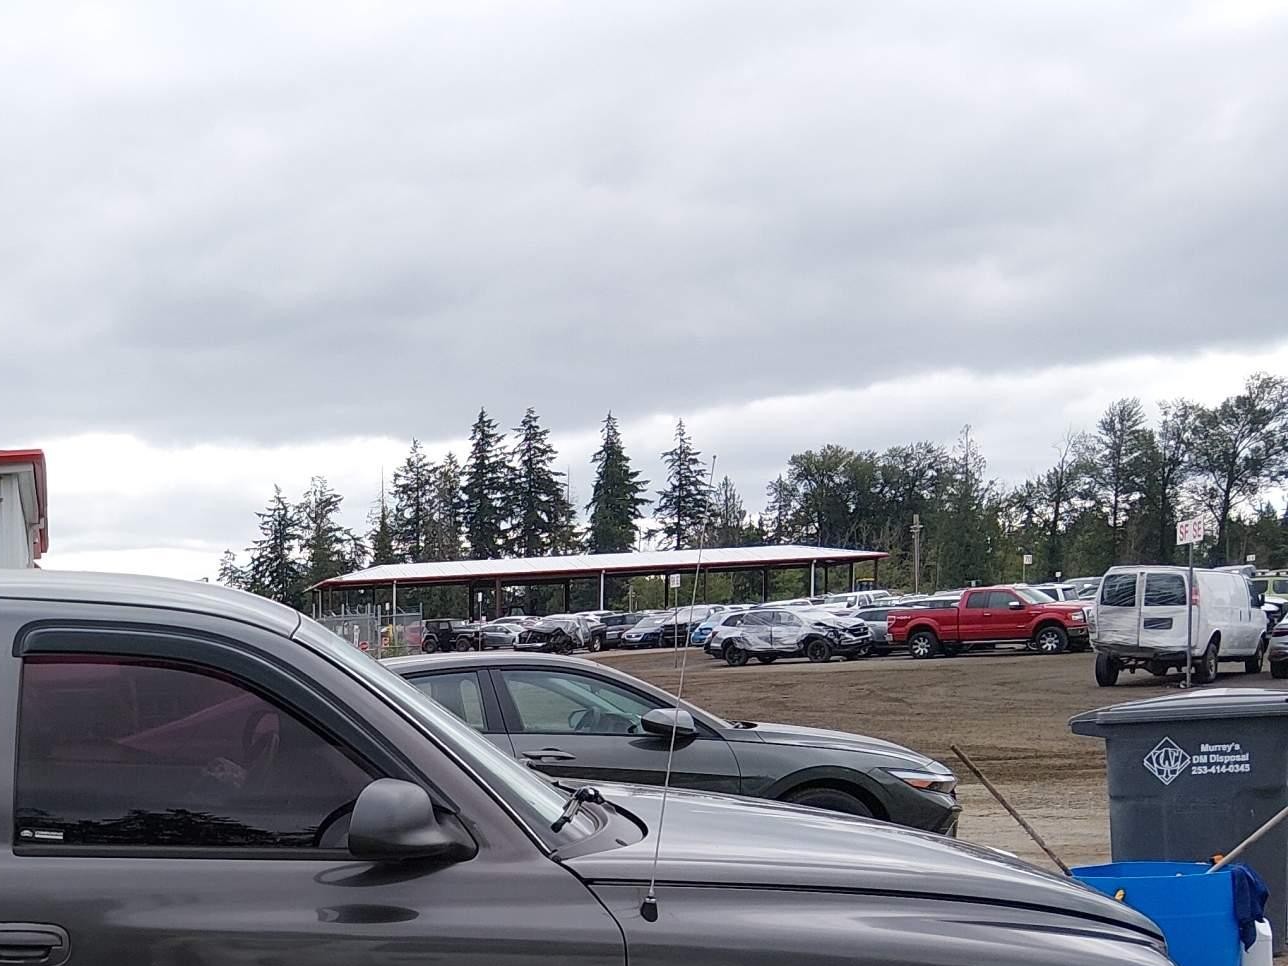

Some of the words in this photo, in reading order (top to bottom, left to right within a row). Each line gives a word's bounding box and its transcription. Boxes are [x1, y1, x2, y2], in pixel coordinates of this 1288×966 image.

[1200, 742, 1240, 752] Murrey's
[1192, 755, 1208, 763] DM
[1209, 752, 1250, 764] Disposal
[1191, 763, 1250, 774] 253-414-0345
